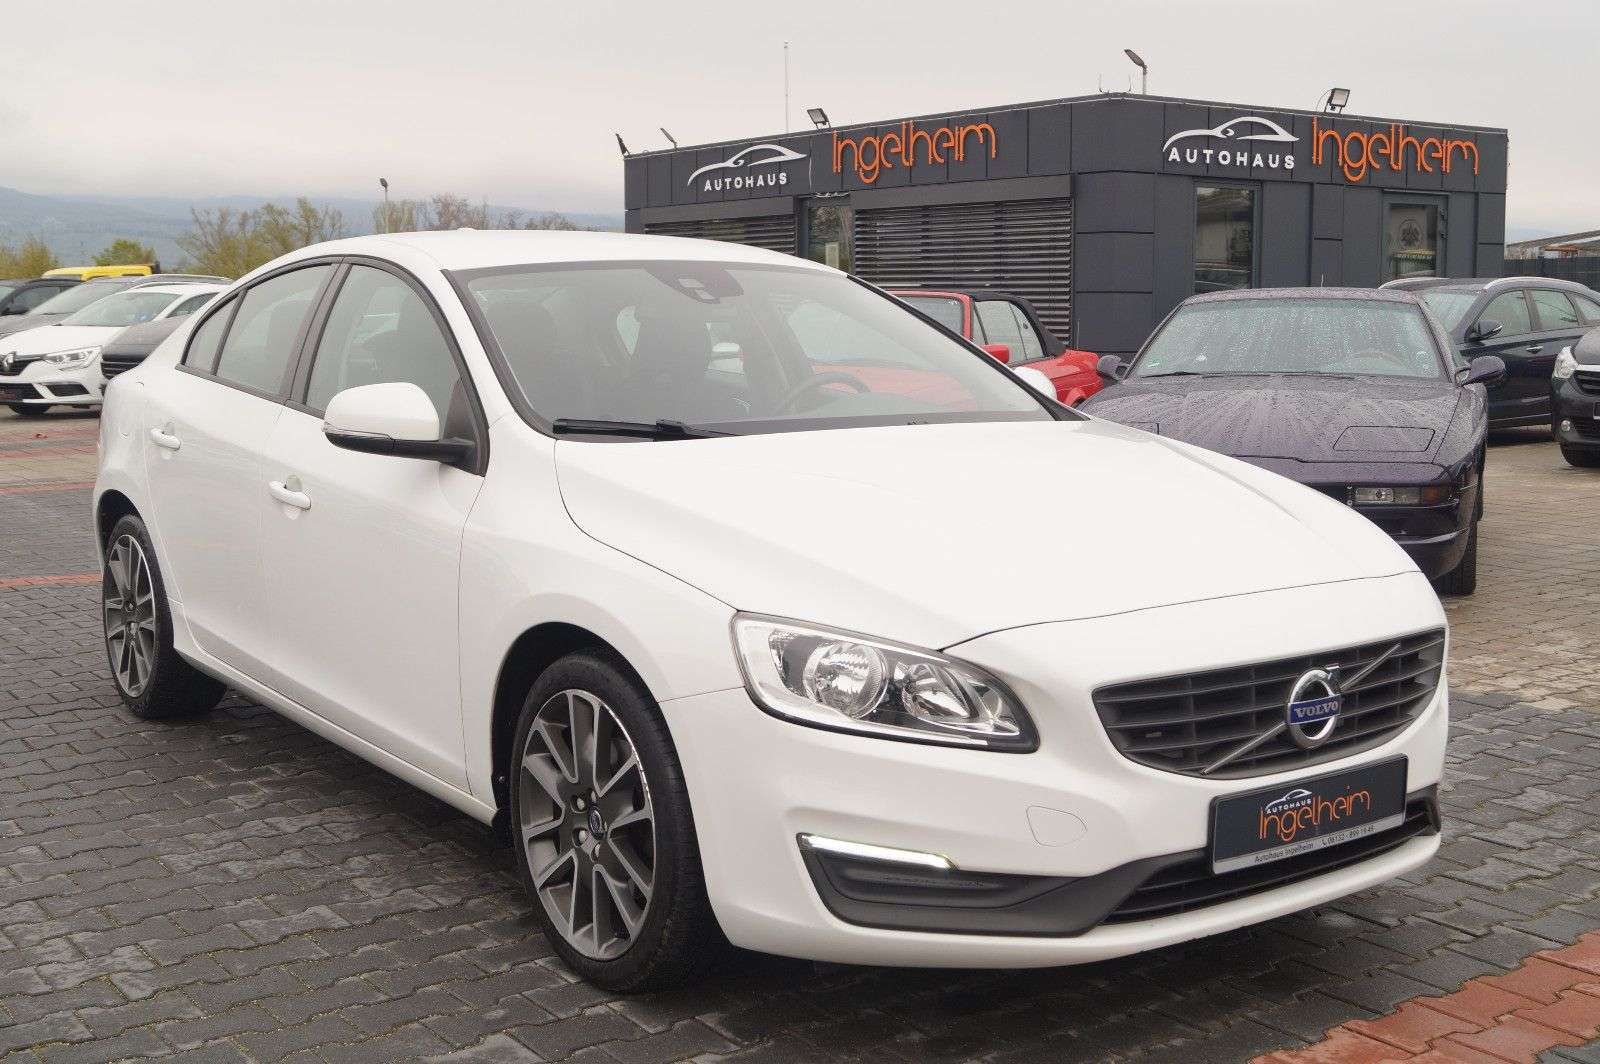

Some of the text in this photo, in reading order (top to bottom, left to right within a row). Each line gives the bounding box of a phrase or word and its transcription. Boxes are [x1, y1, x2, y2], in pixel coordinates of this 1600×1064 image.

[703, 120, 997, 192] AUTOHAUS Ingelheim
[1167, 115, 1480, 182] AUTOHAUS Ingelheim
[1294, 701, 1339, 718] VOLVO
[1266, 798, 1313, 815] AUTOHAUS
